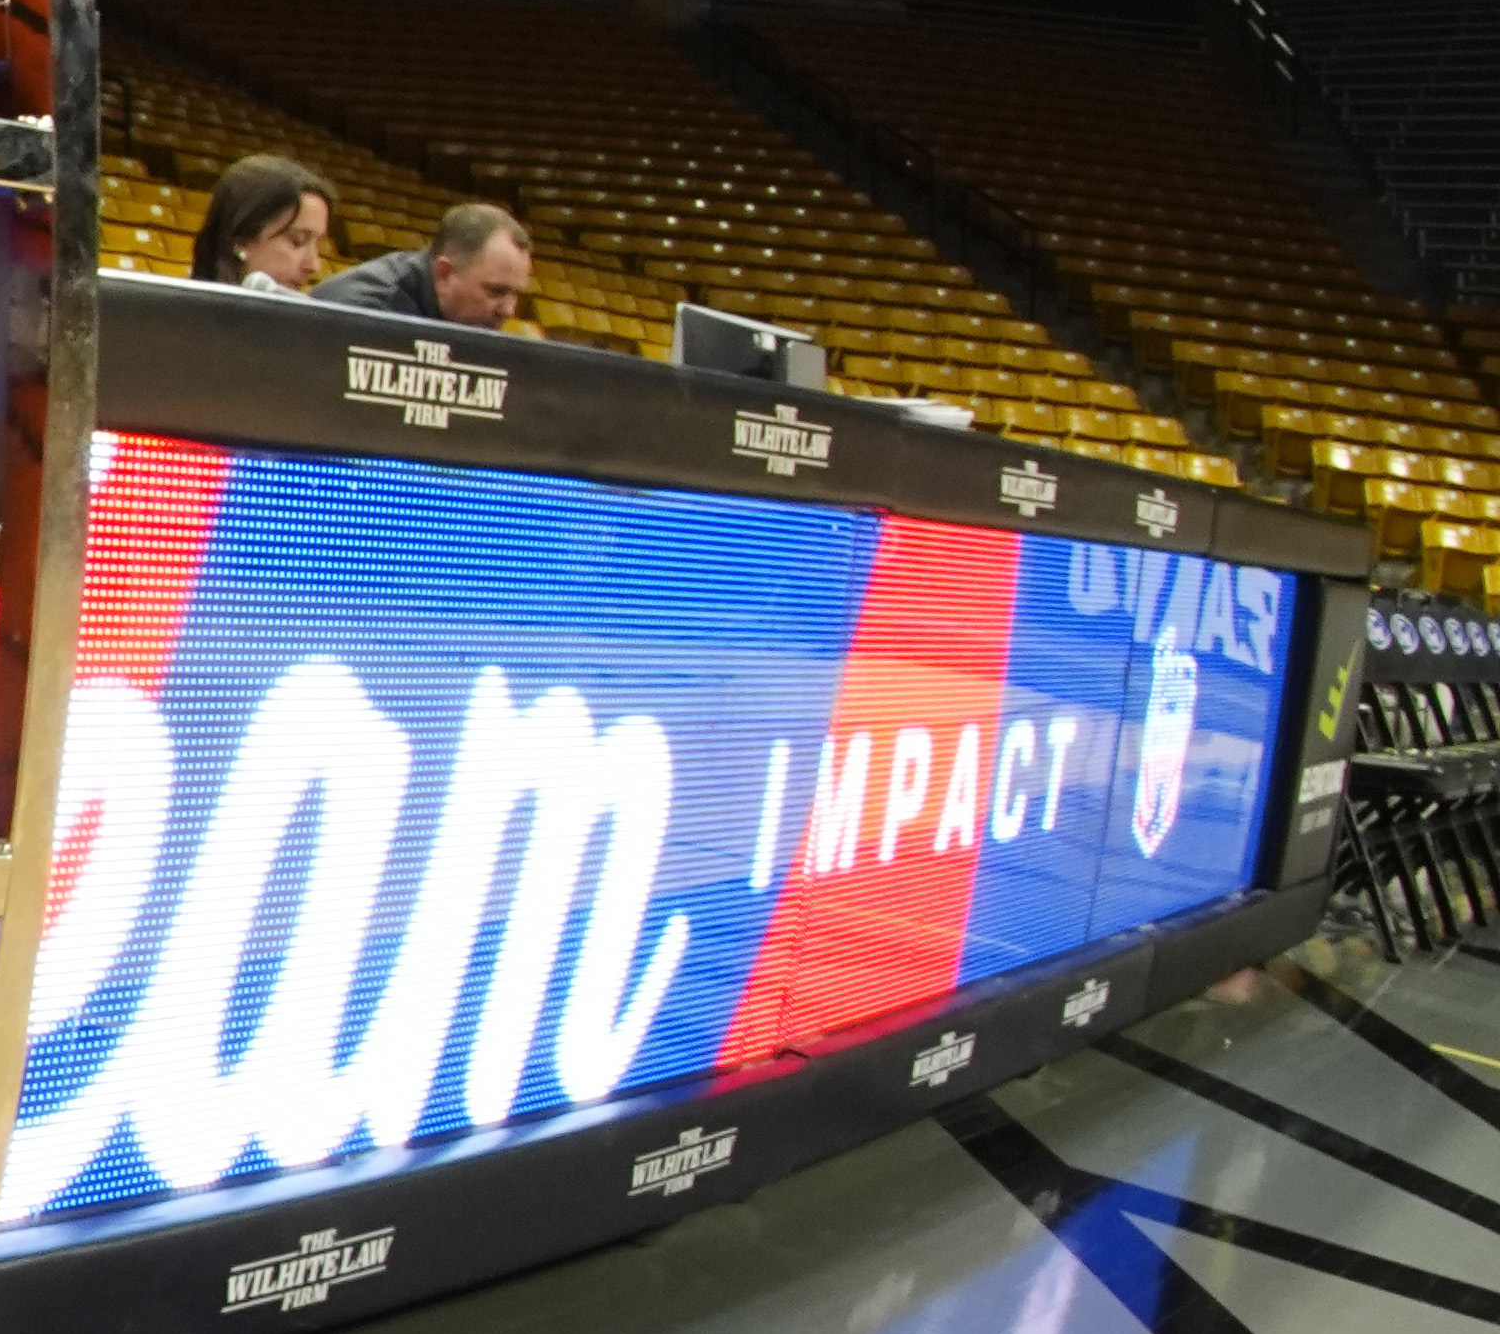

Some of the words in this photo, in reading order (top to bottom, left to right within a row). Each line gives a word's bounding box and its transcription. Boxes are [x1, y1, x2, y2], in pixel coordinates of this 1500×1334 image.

[414, 339, 451, 364] THE
[348, 357, 457, 403] WILHITE
[457, 374, 508, 410] LAW
[404, 401, 450, 430] FIRM
[750, 720, 1077, 888] IMPACT
[300, 1227, 337, 1254] THE
[227, 1250, 340, 1304] WILHITE
[341, 1235, 394, 1274] LAW
[282, 1282, 330, 1312] FIRM
